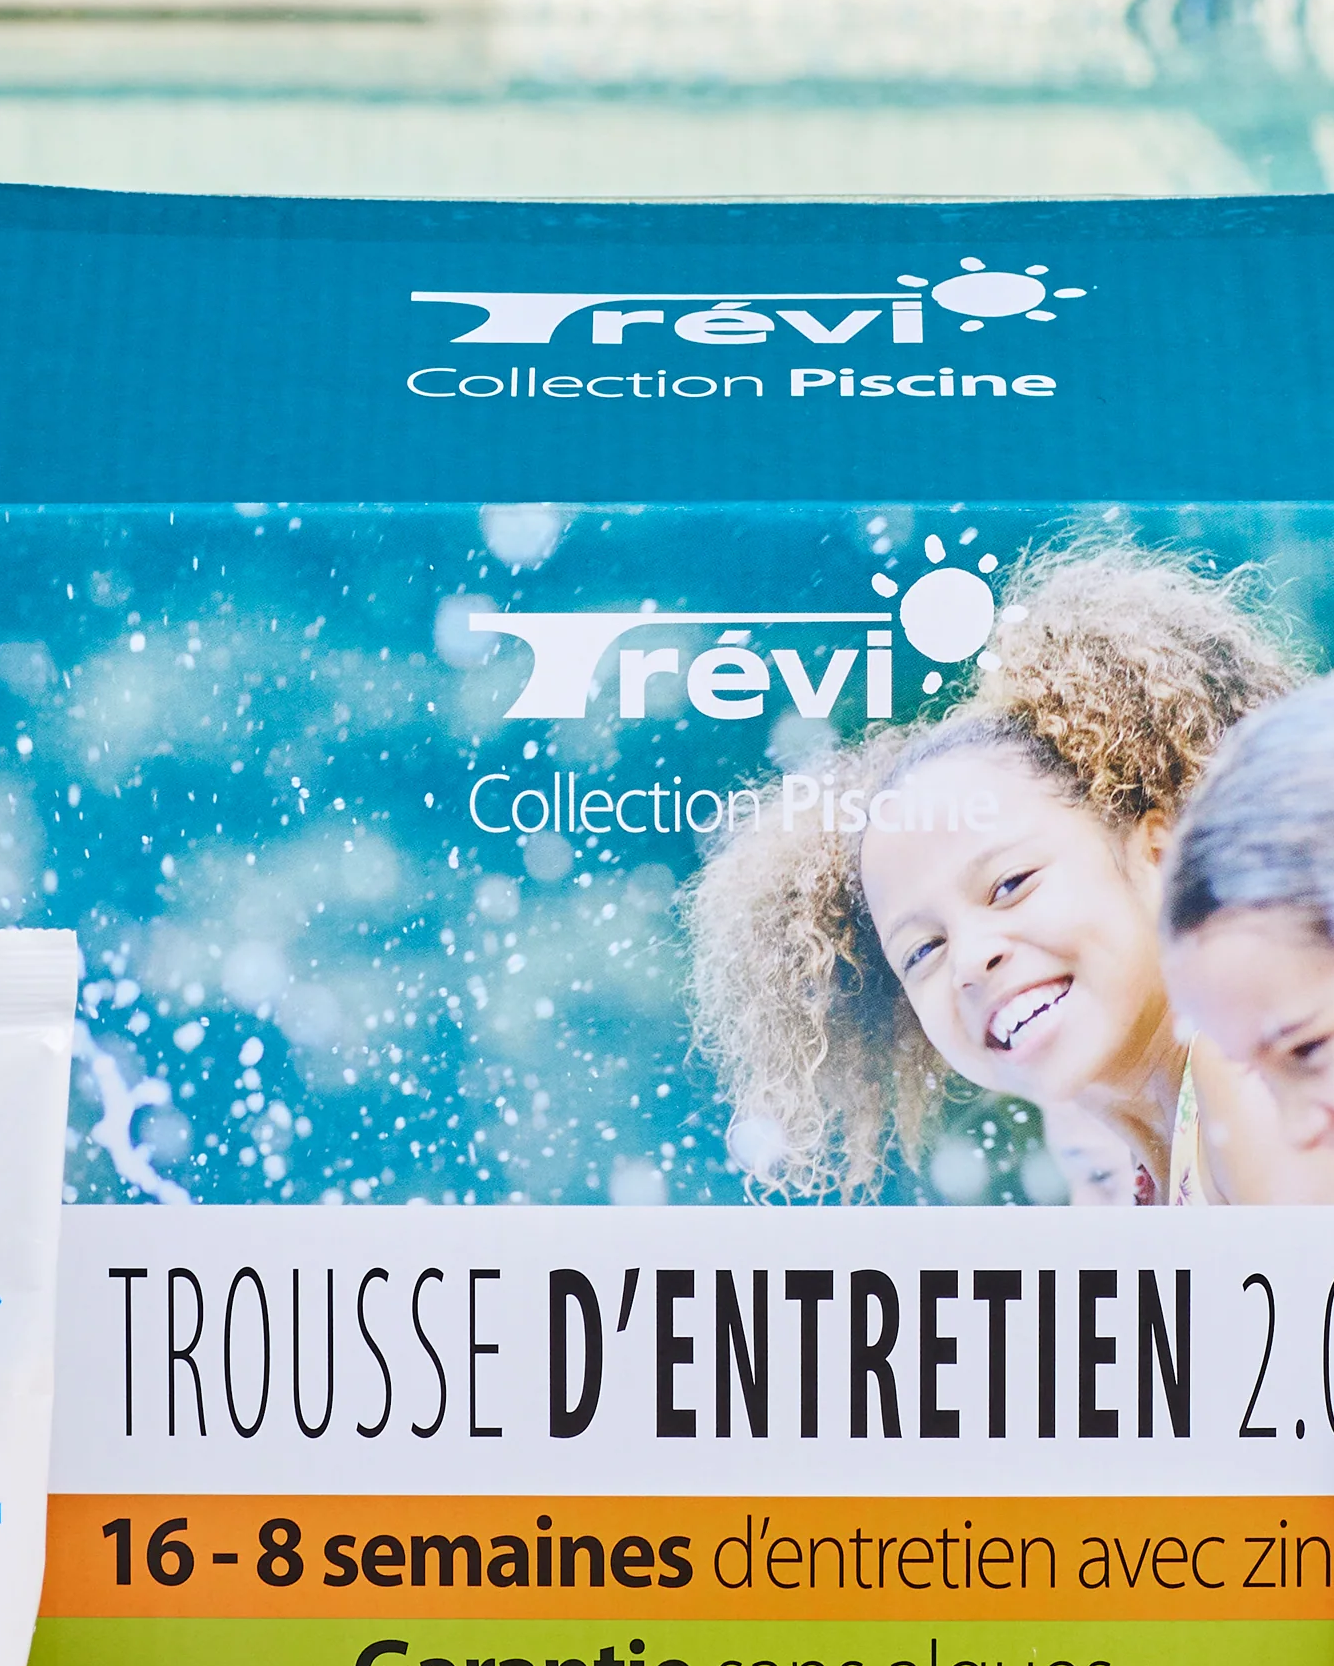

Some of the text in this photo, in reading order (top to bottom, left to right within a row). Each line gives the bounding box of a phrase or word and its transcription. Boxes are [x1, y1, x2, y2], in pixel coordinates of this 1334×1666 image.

[412, 291, 922, 344] Trévi
[407, 367, 1057, 399] Collection Piscine
[469, 612, 893, 720] Trévi
[469, 774, 1000, 834] Collection Piscine
[108, 1266, 503, 1439] TROUSSE
[548, 1267, 1191, 1439] D'ENTRETIEN
[102, 1517, 195, 1587] 16
[213, 1552, 238, 1564] -
[256, 1517, 304, 1587] 8
[323, 1515, 693, 1588] semaines
[713, 1514, 1056, 1590] d'entretien
[1078, 1536, 1224, 1589] avec
